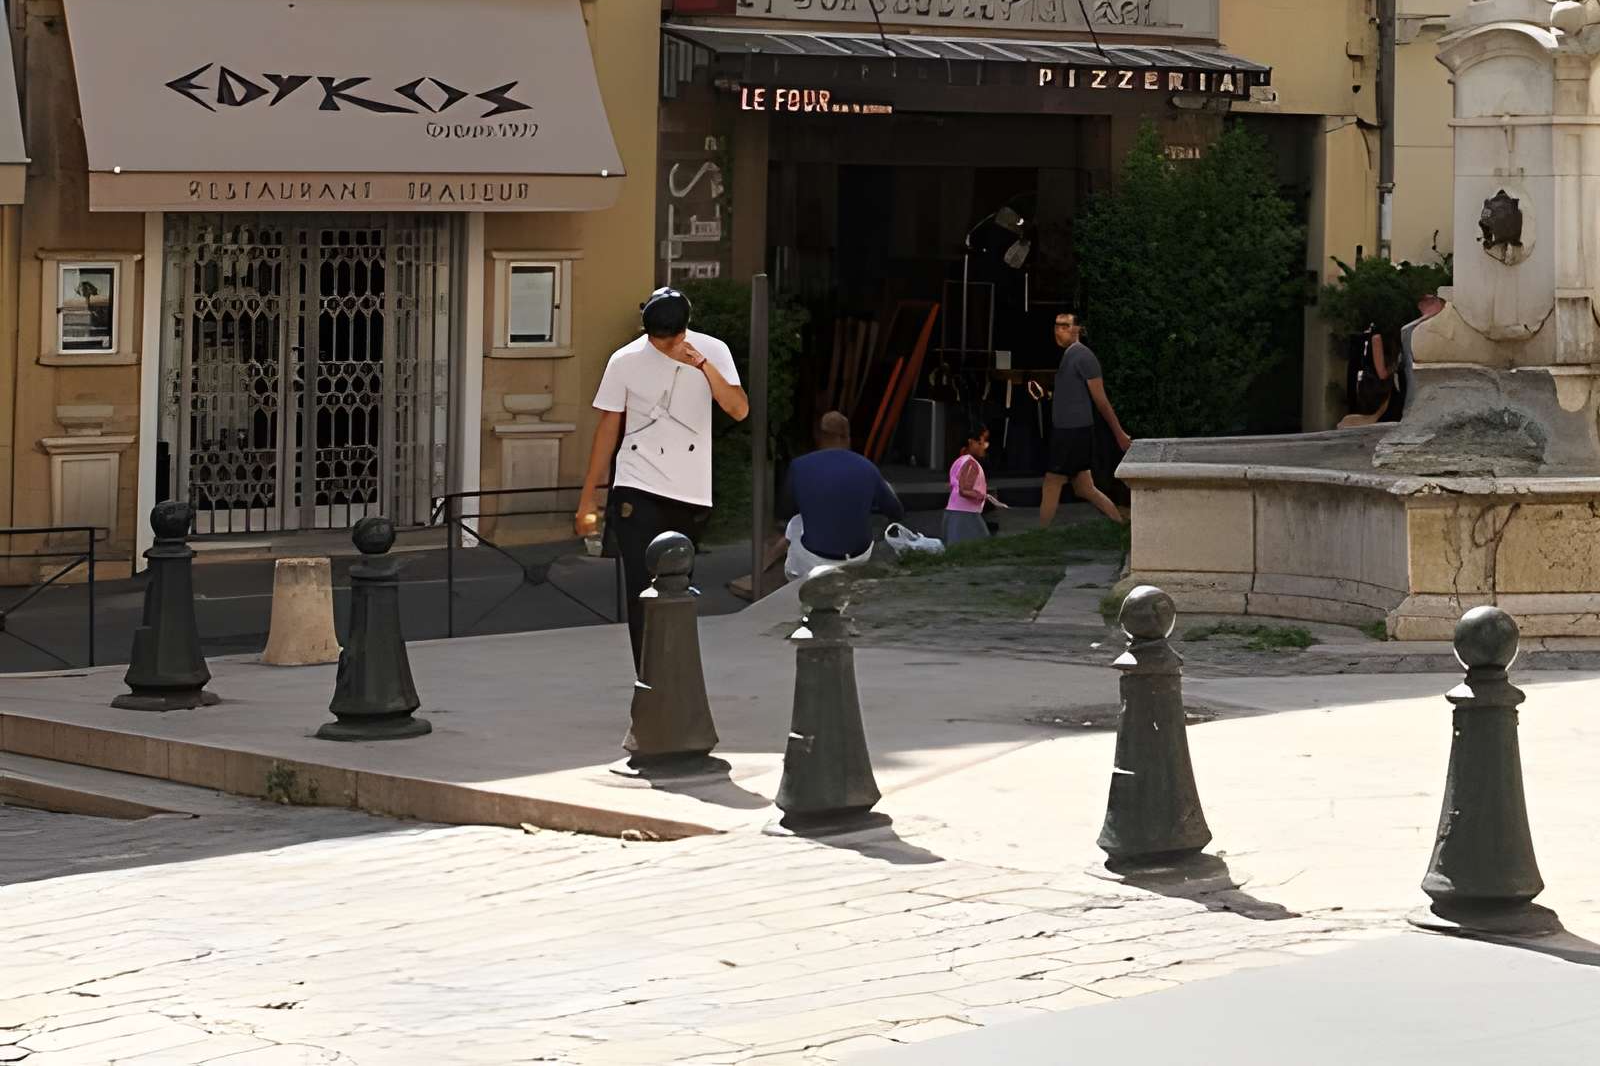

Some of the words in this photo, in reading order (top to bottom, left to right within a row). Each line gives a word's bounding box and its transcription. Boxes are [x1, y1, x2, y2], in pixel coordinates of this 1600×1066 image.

[164, 62, 534, 119] EDYKOS
[1038, 67, 1235, 93] PIZZERIA
[740, 87, 766, 111] LE
[774, 88, 831, 112] FOUR
[188, 180, 372, 201] RESTAURANT
